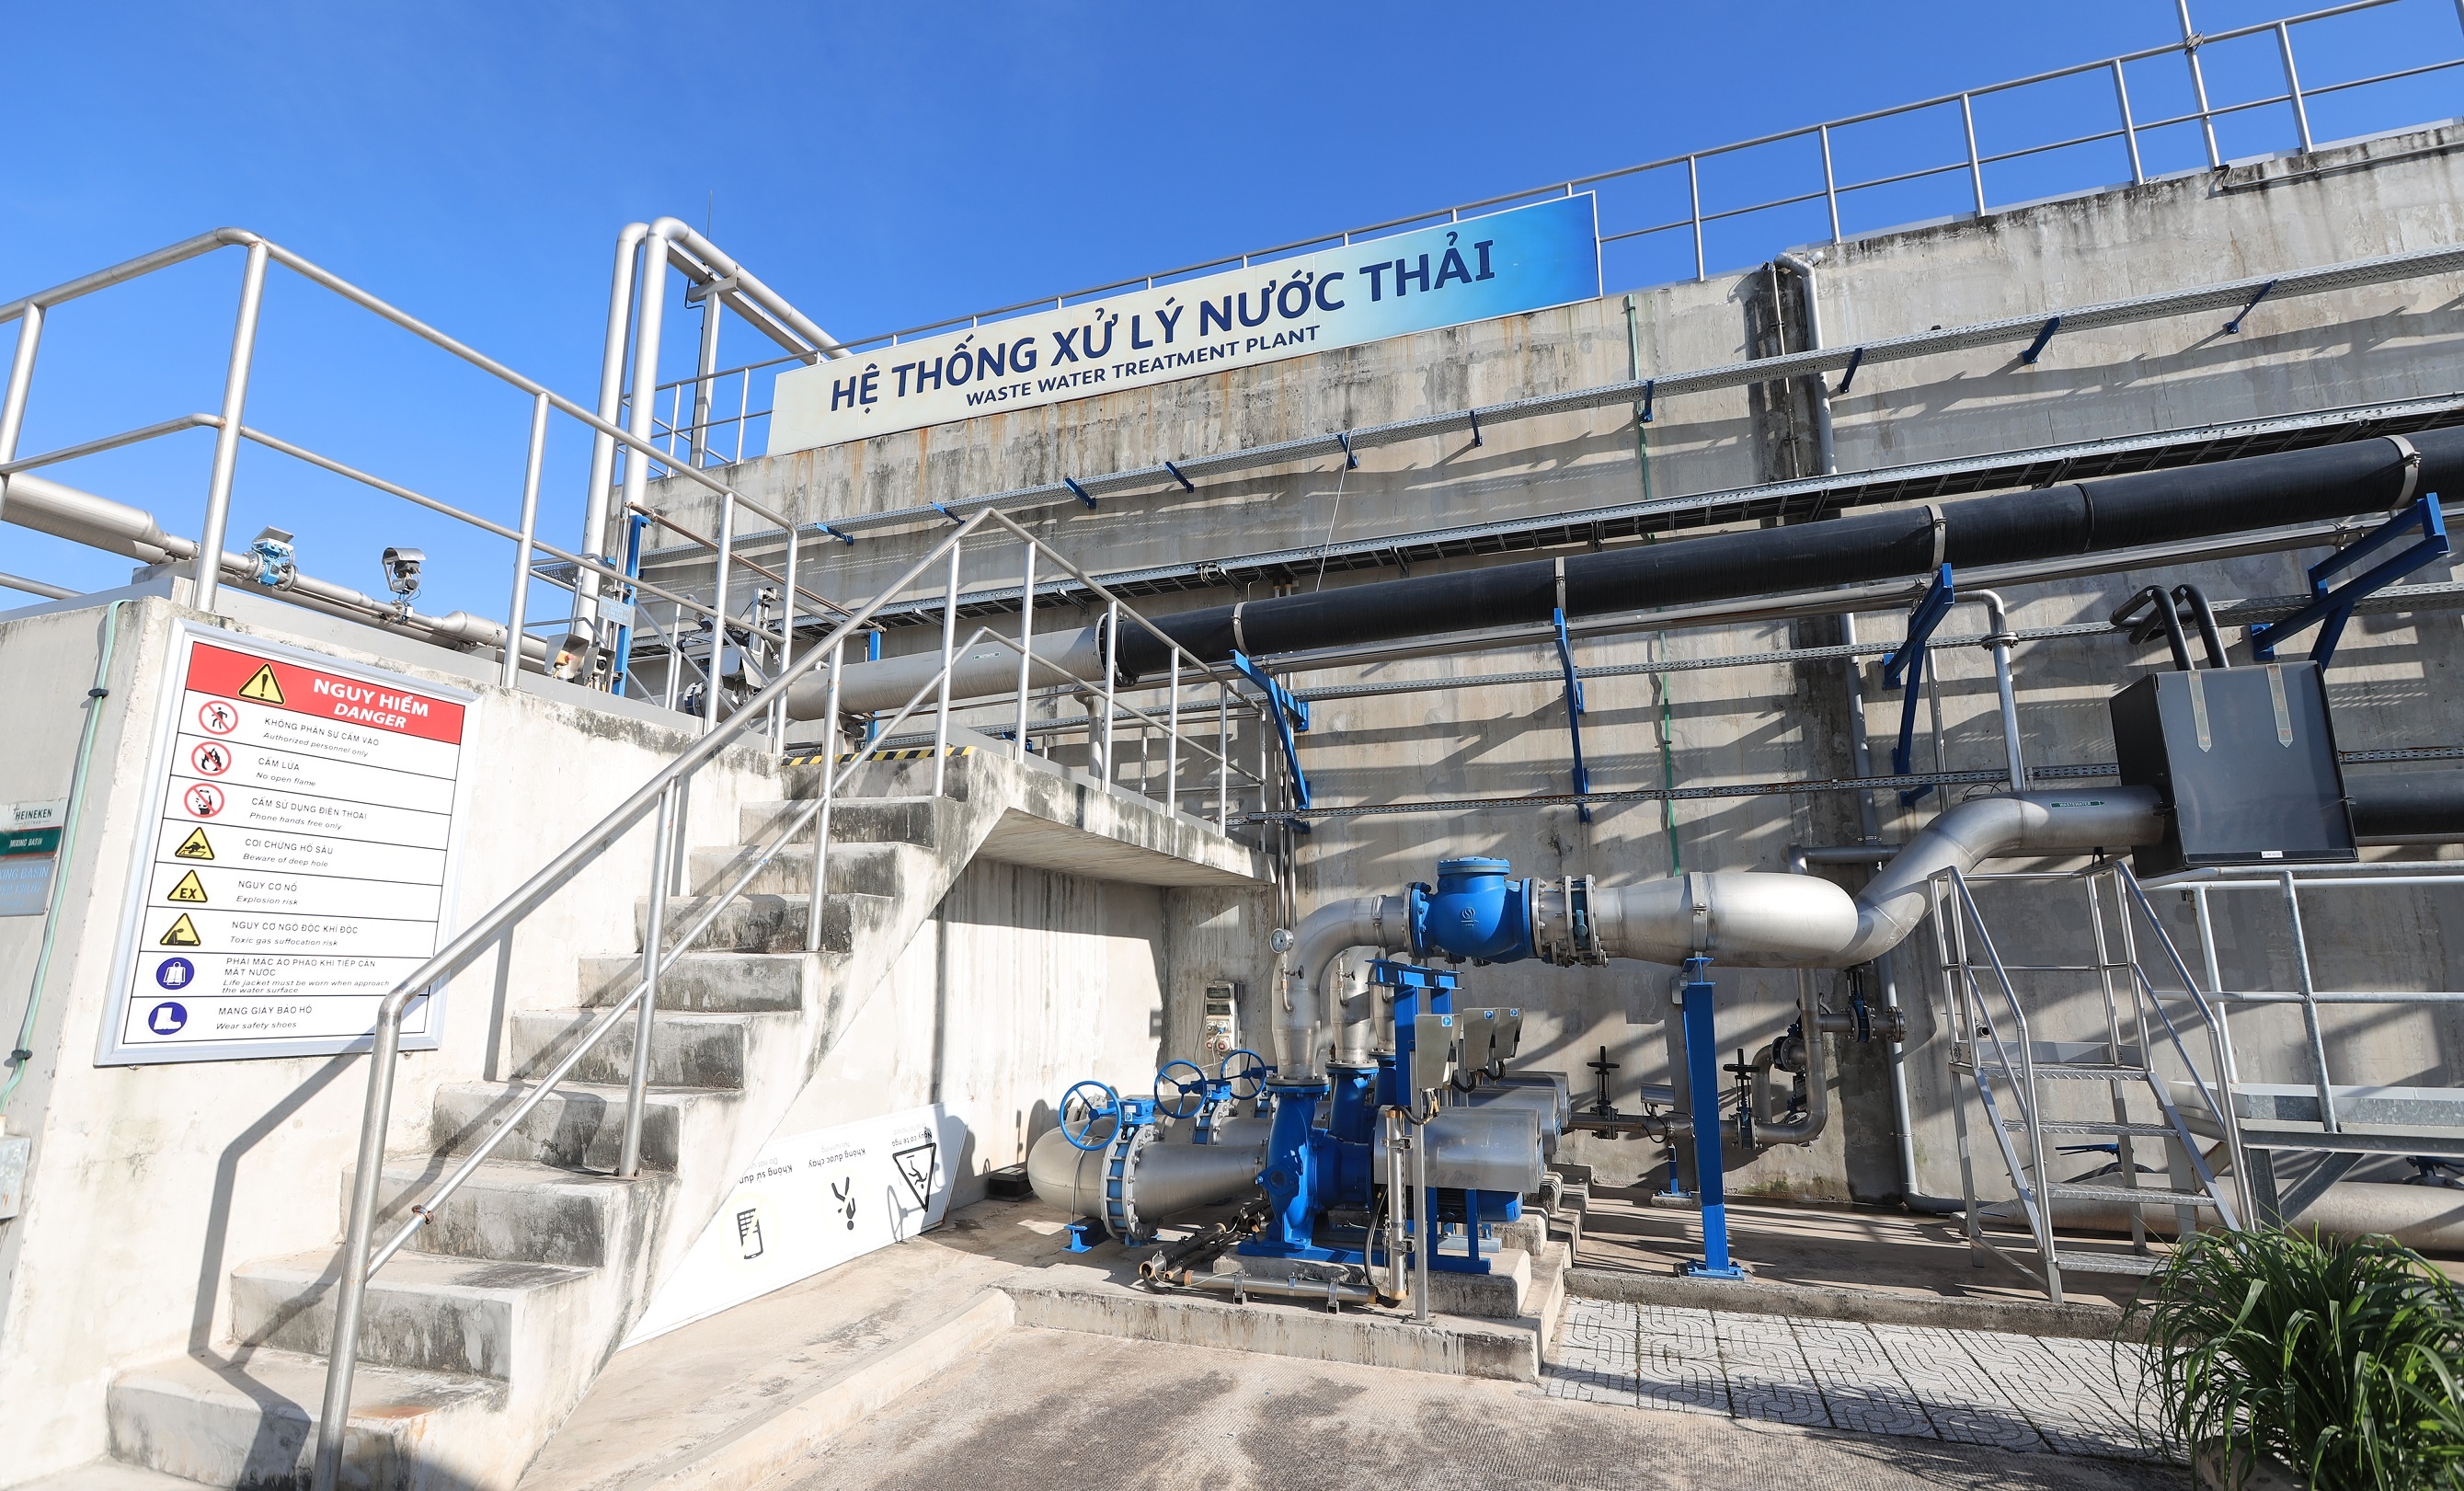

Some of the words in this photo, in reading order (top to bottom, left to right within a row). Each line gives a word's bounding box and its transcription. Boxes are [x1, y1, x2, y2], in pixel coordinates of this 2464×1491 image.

[831, 362, 881, 414] HỆ
[892, 334, 1037, 393] THỐNG
[1051, 307, 1119, 368] XỬ
[1130, 297, 1183, 350] LÝ
[1198, 269, 1346, 337] NƯỚC
[1359, 232, 1496, 303] THẢI
[966, 378, 1033, 407] WASTE
[1037, 368, 1106, 396] WATER
[1110, 343, 1237, 380] TREATMENT
[1244, 324, 1320, 356] PLANT
[313, 678, 375, 705] NGUY
[379, 695, 430, 717] HIỂM
[334, 703, 407, 728] DANGER
[265, 717, 298, 730] KHÔNG
[263, 732, 309, 746] Authorized
[311, 741, 351, 752] personnel
[351, 749, 368, 758] only
[256, 772, 269, 780] No
[270, 774, 292, 783] open
[294, 777, 316, 787] flame
[16, 809, 52, 820] HEINEKEN
[249, 811, 278, 821] Phone
[280, 816, 305, 825] hands
[307, 819, 323, 828] free
[326, 822, 343, 831] only
[29, 837, 44, 846] BASIN
[243, 854, 276, 863] Beware
[289, 858, 309, 866] deep
[20, 866, 50, 879] BASIN
[237, 880, 265, 889] NGUY
[180, 888, 197, 900] EX
[232, 921, 259, 930] NGUY
[262, 922, 276, 931] CƠ
[219, 1007, 248, 1015] MANG
[242, 1022, 269, 1030] safety
[768, 1164, 793, 1177] Không
[739, 1174, 754, 1185] dụn
